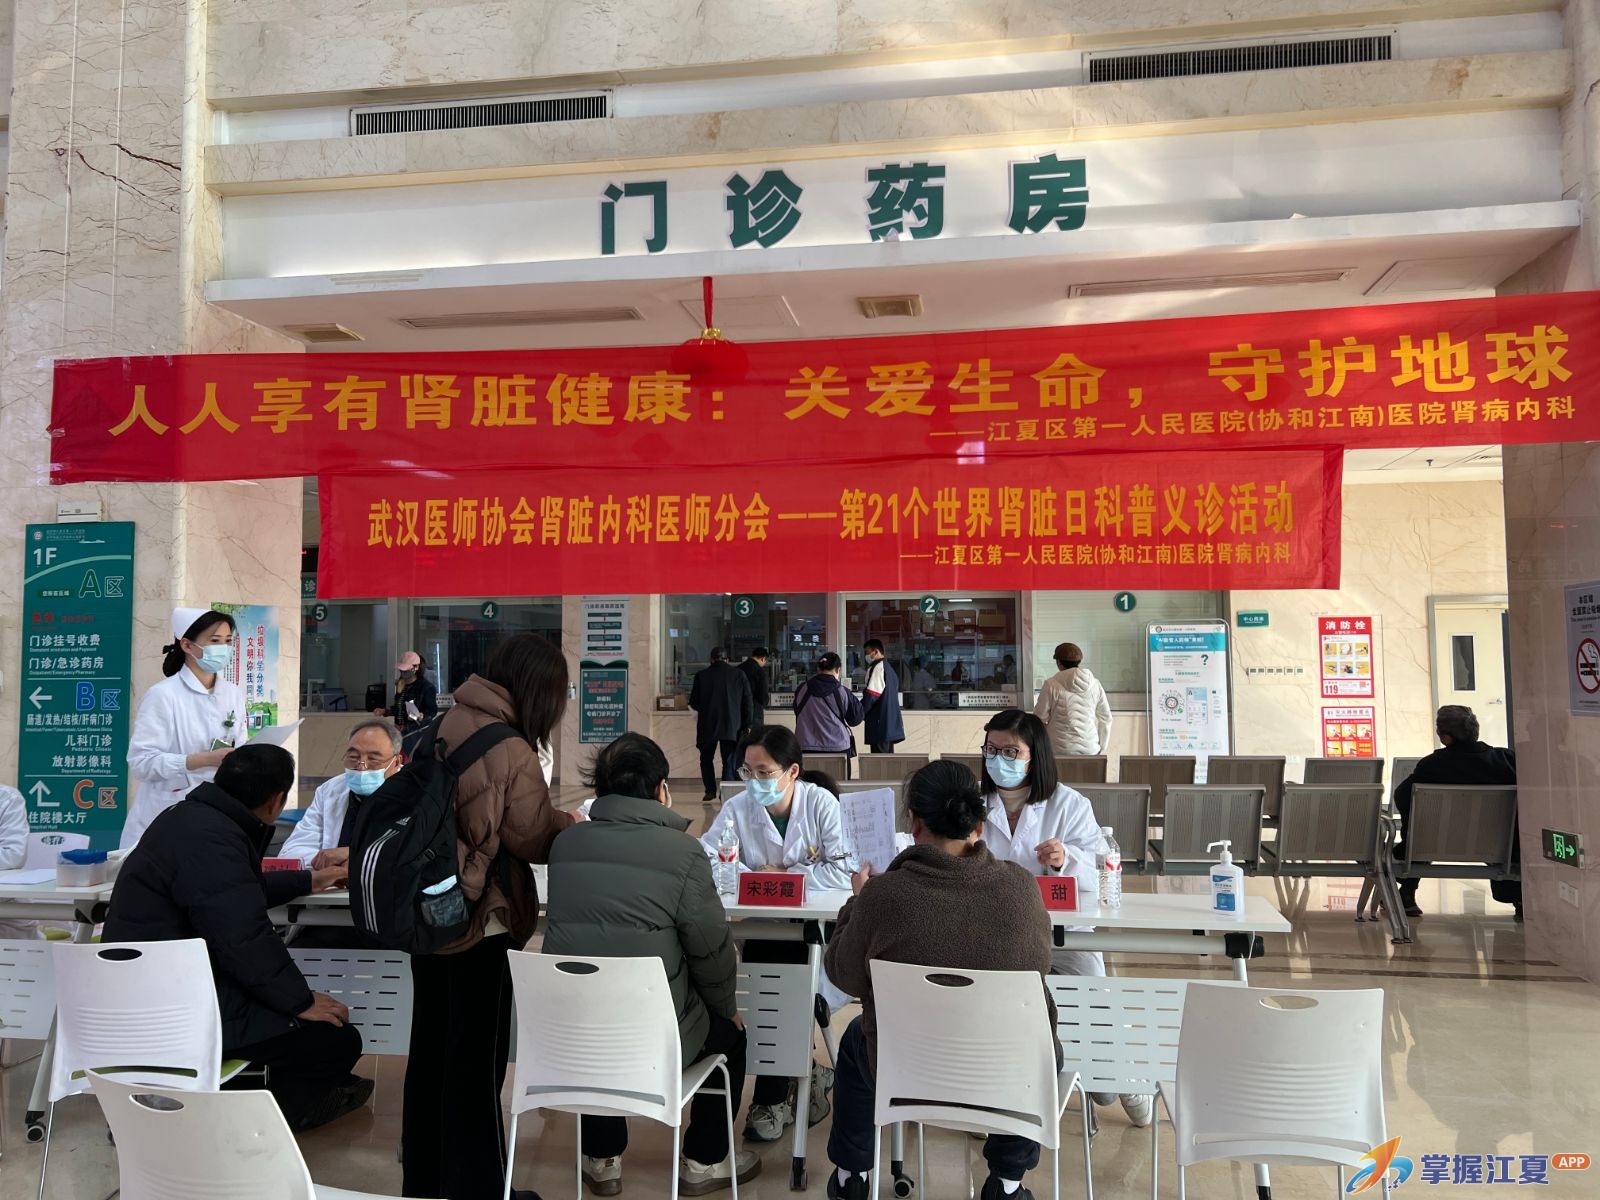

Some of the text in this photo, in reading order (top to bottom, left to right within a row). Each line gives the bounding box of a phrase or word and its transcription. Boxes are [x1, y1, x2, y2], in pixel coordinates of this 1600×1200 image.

[601, 154, 1090, 255] 门诊药房
[33, 547, 57, 565] 1F
[79, 569, 124, 598] A区
[739, 600, 750, 615] 3
[924, 598, 936, 613] 2
[1120, 594, 1129, 610] 1
[316, 606, 325, 620] 5
[483, 603, 494, 618] 4
[1325, 620, 1366, 630] 消防栓
[29, 634, 100, 647] 门诊挂号收费
[29, 657, 104, 669] 门诊/急诊药房
[75, 681, 121, 711] B区
[1325, 685, 1339, 694] 119
[26, 713, 113, 726] 肠道/发热/结核/肝病门诊
[65, 734, 112, 747] 儿科门诊
[52, 755, 112, 768] 放射影像科
[73, 779, 118, 809] C区
[28, 811, 87, 824] 住院楼大厅
[746, 880, 796, 898] 宋彩霞
[1050, 883, 1068, 901] 甜
